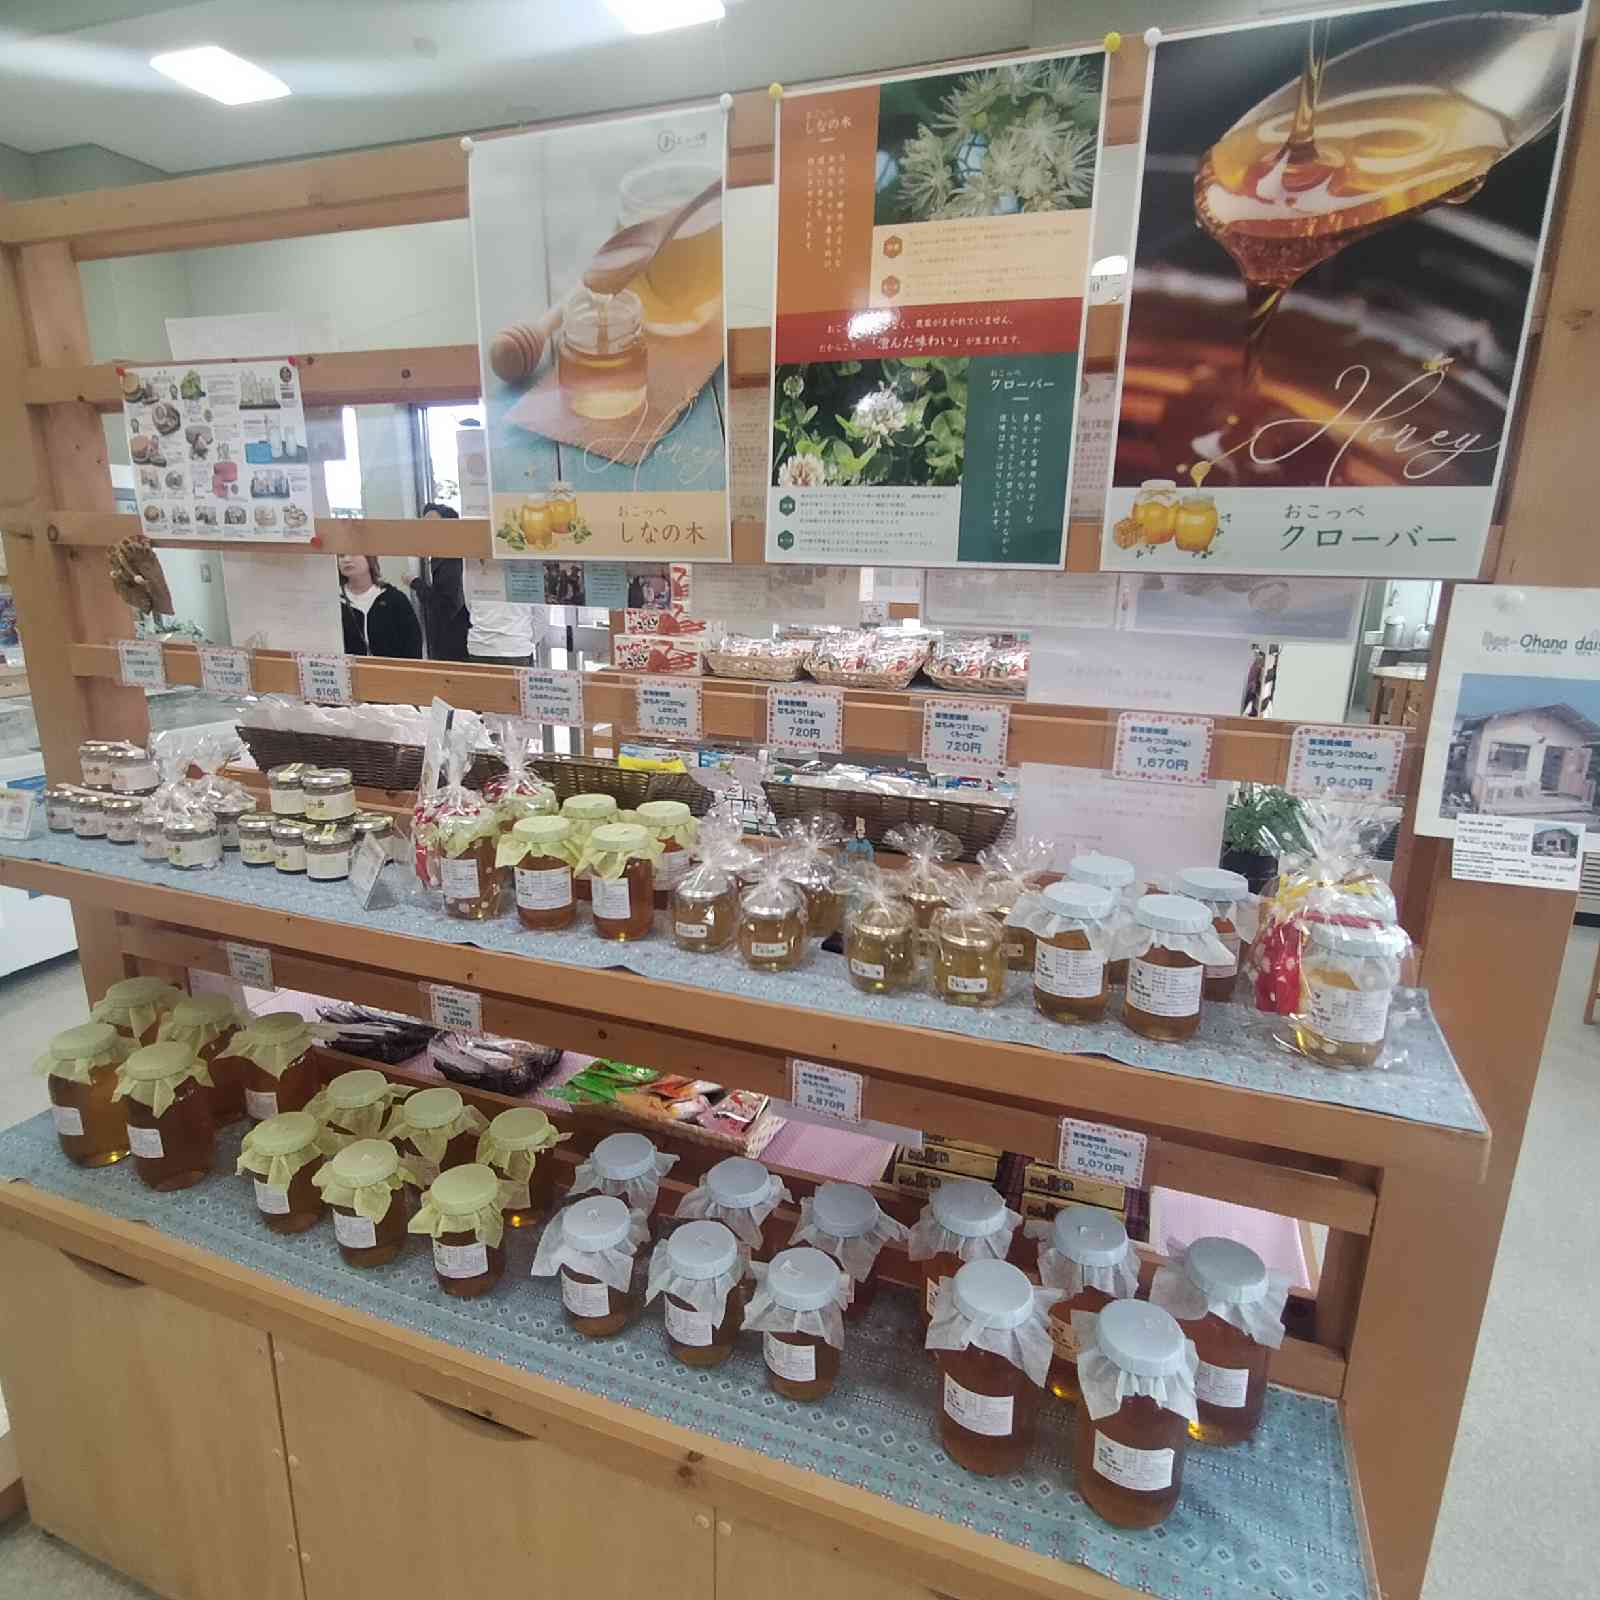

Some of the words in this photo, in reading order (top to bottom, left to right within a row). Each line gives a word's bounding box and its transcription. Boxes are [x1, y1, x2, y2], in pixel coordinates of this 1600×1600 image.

[990, 378, 1055, 391] クローバー
[1250, 365, 1501, 487] Honey
[1284, 504, 1366, 520] おこっぺ
[620, 522, 706, 545] しなの木
[1280, 525, 1457, 551] クローバー
[1519, 633, 1568, 649] Ohana
[787, 726, 821, 740] 720円
[945, 740, 982, 754] 720円
[1135, 756, 1190, 772] 1,670円
[1077, 1157, 1125, 1175] 5,070円
